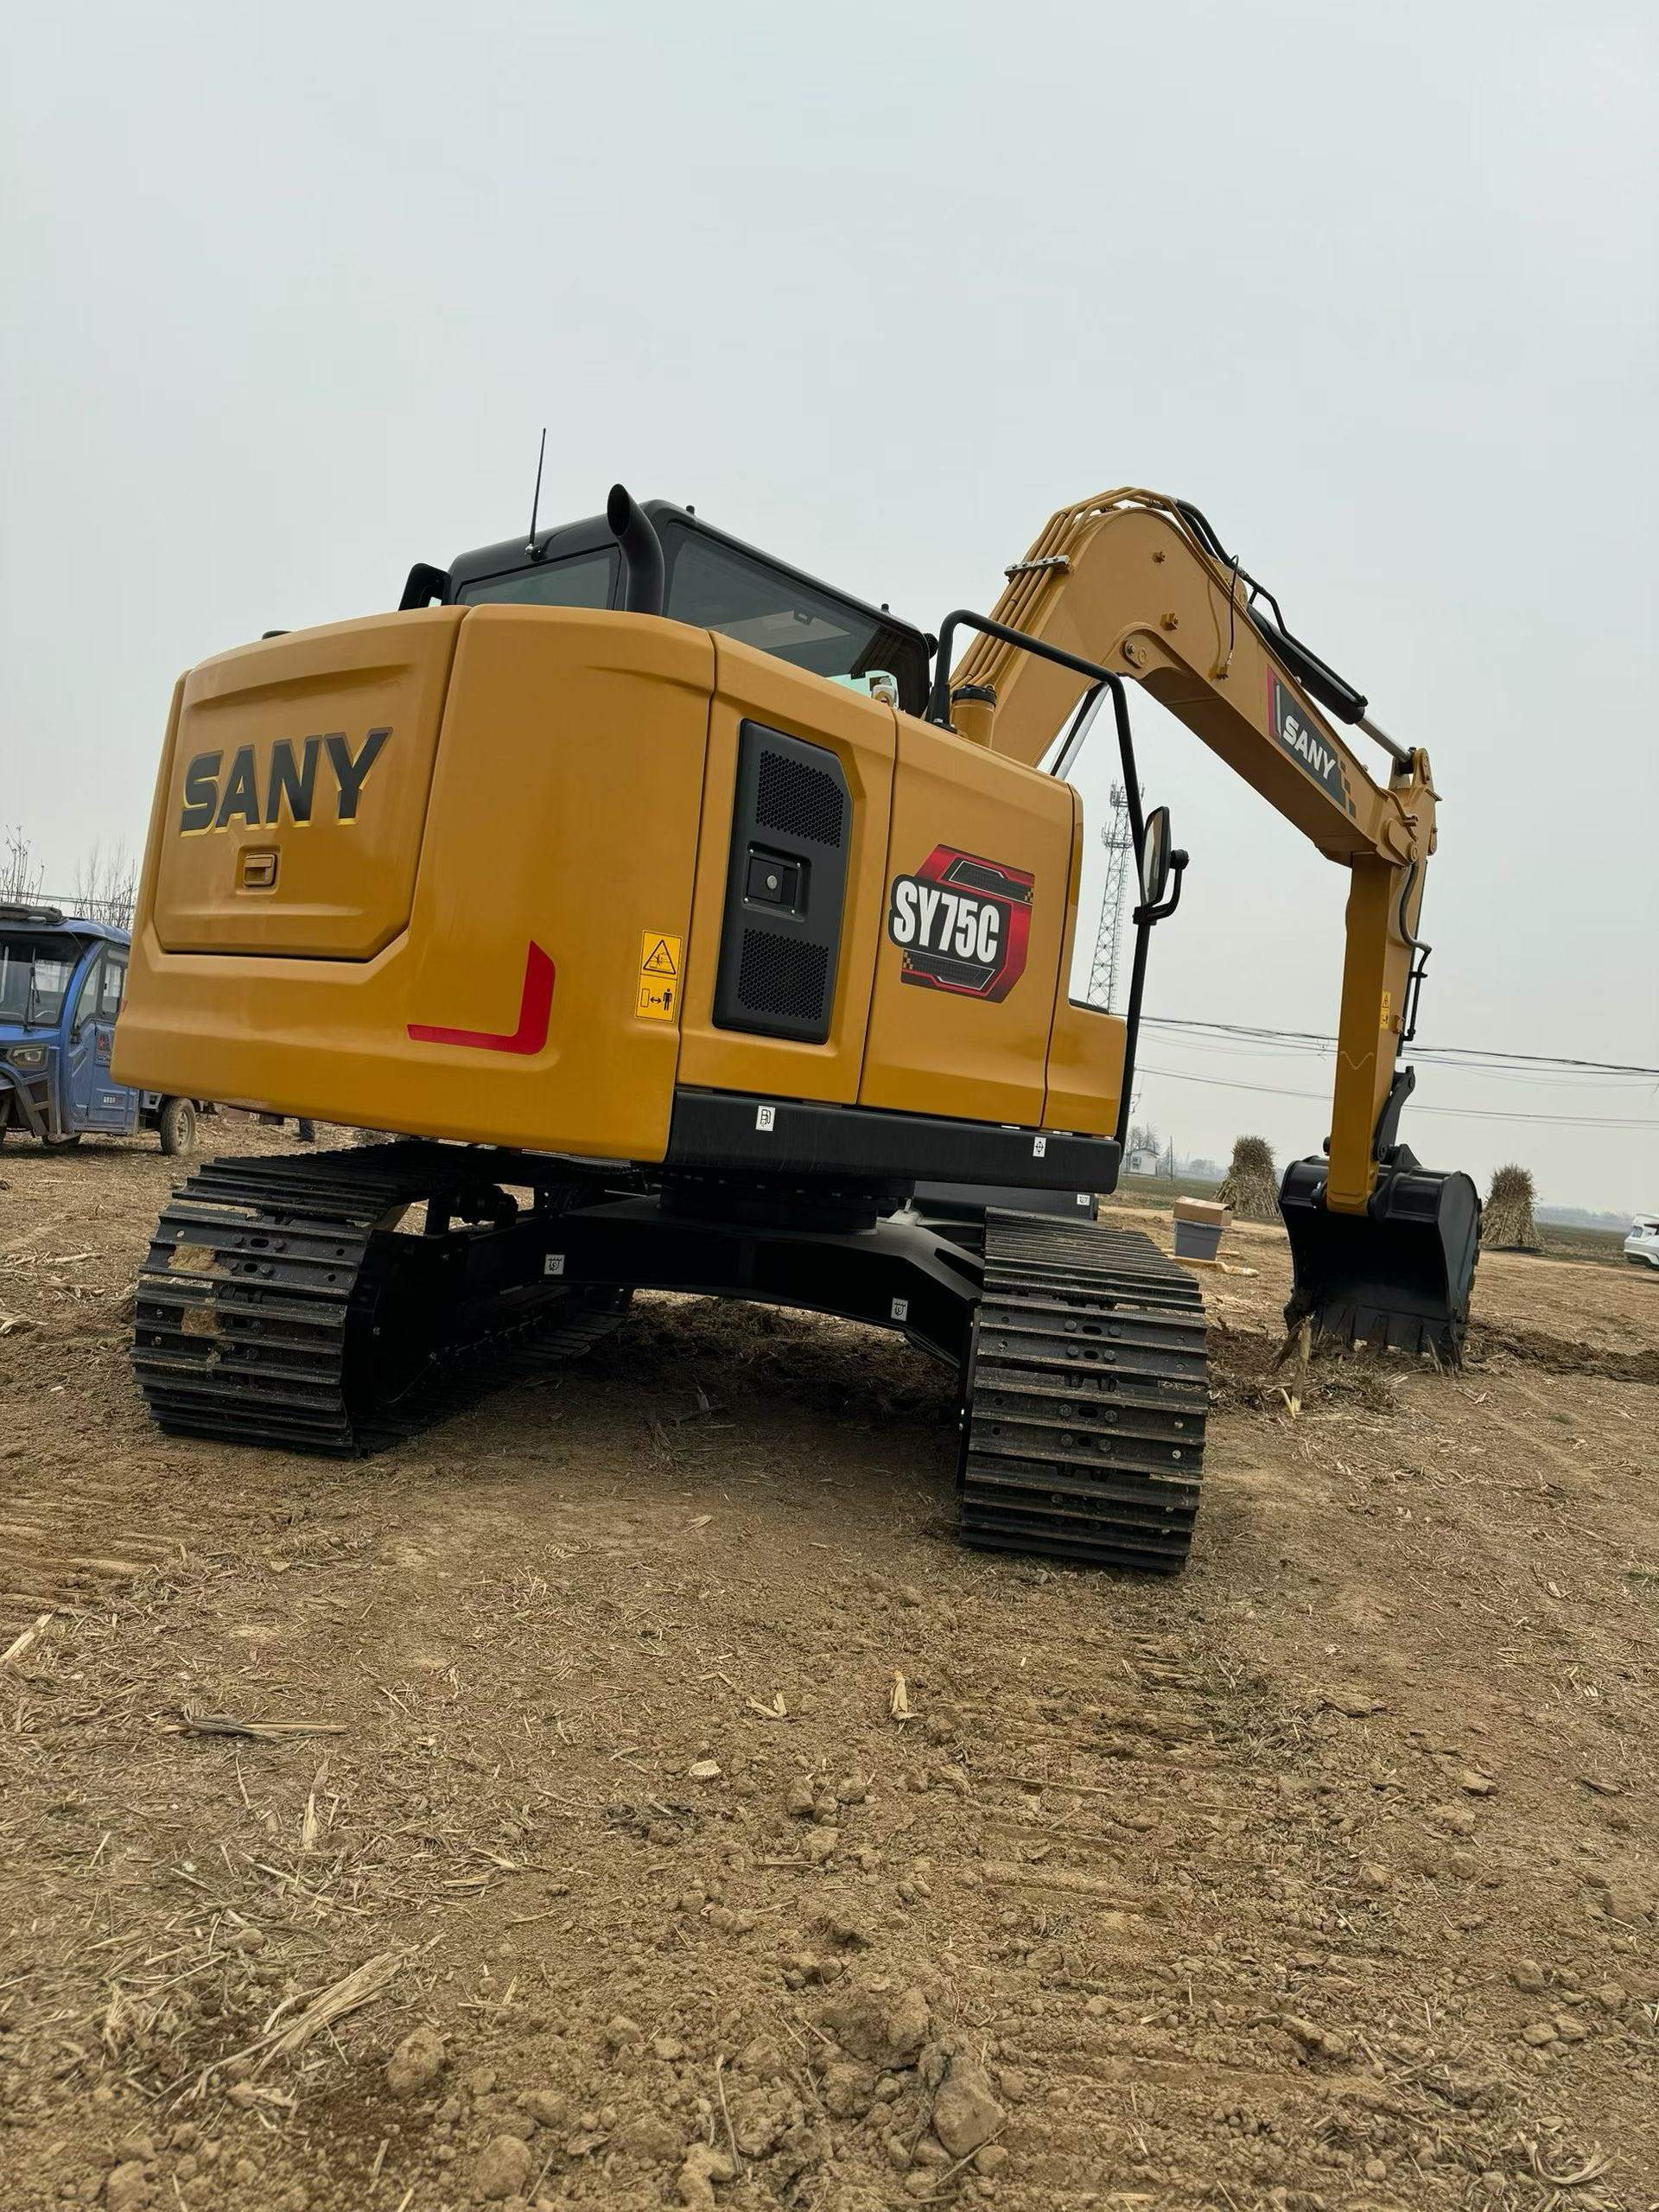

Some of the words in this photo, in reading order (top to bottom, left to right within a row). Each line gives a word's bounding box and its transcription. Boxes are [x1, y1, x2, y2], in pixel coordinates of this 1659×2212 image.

[180, 727, 393, 836] SANY
[1282, 715, 1336, 779] SANY
[893, 880, 1000, 963] SY75C
